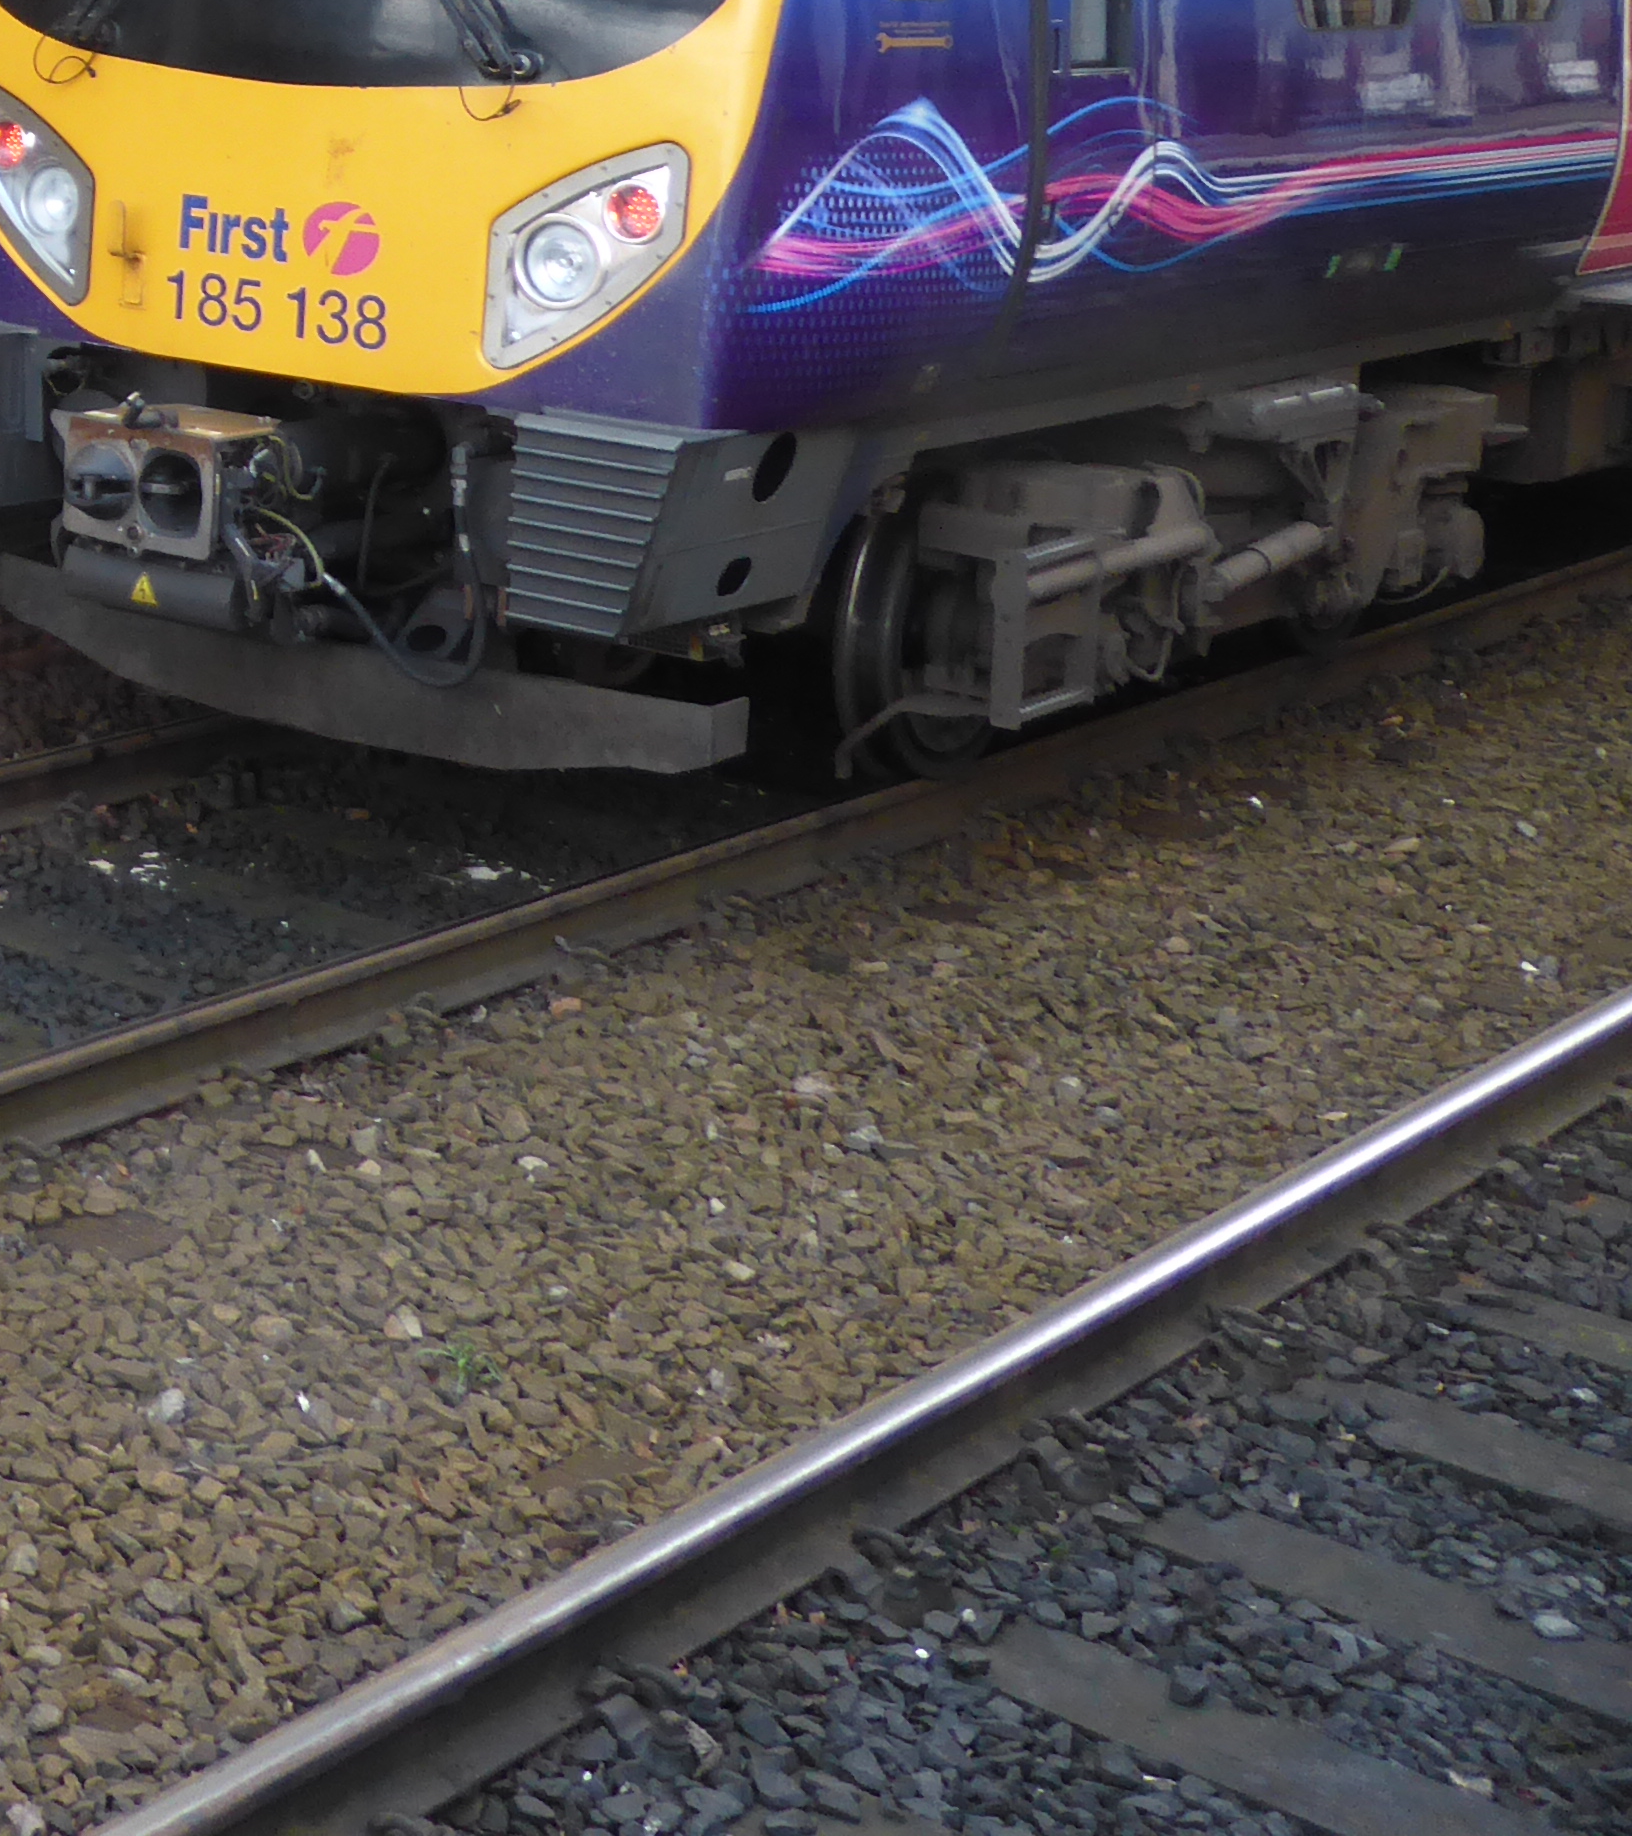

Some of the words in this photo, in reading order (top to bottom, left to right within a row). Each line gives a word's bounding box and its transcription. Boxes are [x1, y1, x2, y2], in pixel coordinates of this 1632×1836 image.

[179, 193, 289, 263] First
[167, 269, 262, 333] 185
[287, 286, 387, 350] 138
